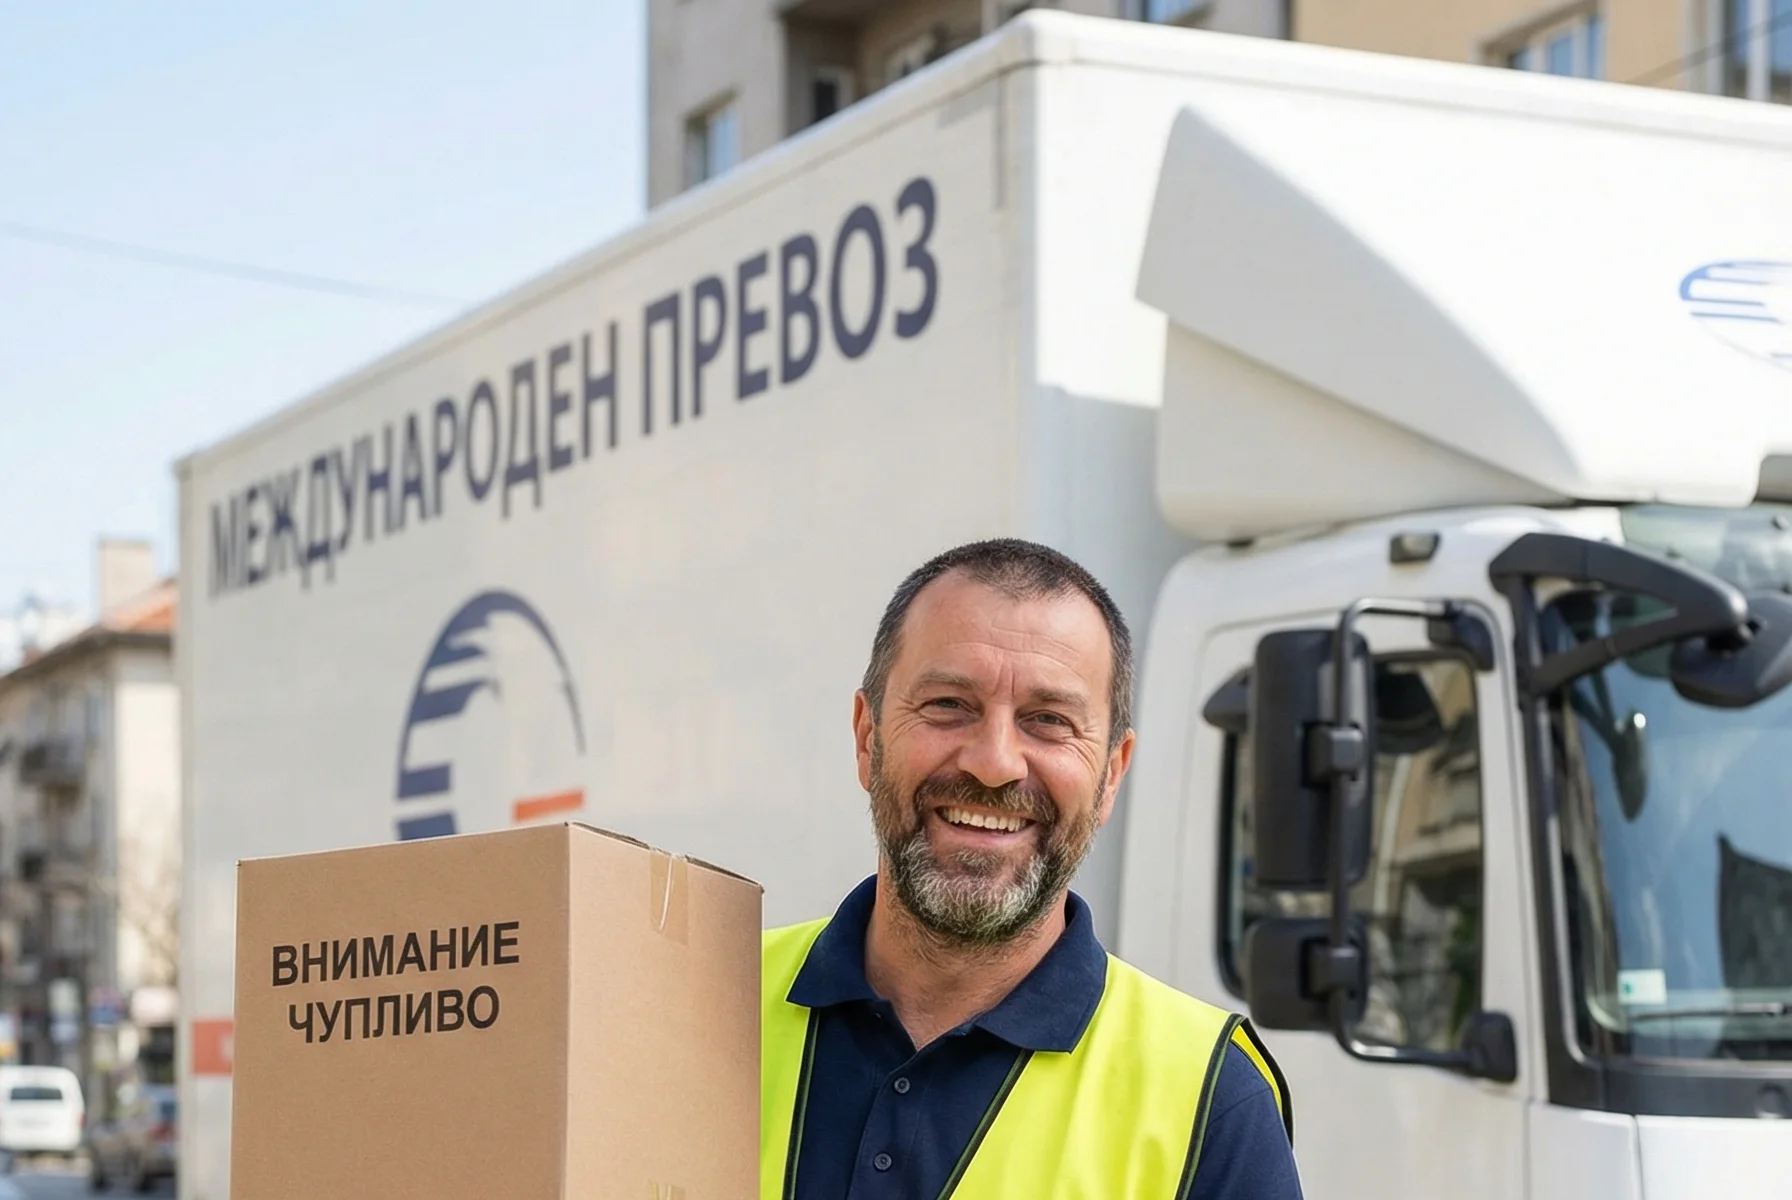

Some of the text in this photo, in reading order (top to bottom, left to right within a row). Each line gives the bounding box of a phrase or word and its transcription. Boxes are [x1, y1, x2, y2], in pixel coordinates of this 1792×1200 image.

[208, 175, 940, 598] МЕЖДУНАРОДЕН ПРЕВОЗ
[272, 920, 520, 987] ВНИМАНИЕ
[288, 985, 500, 1044] ЧУПЛИВО
